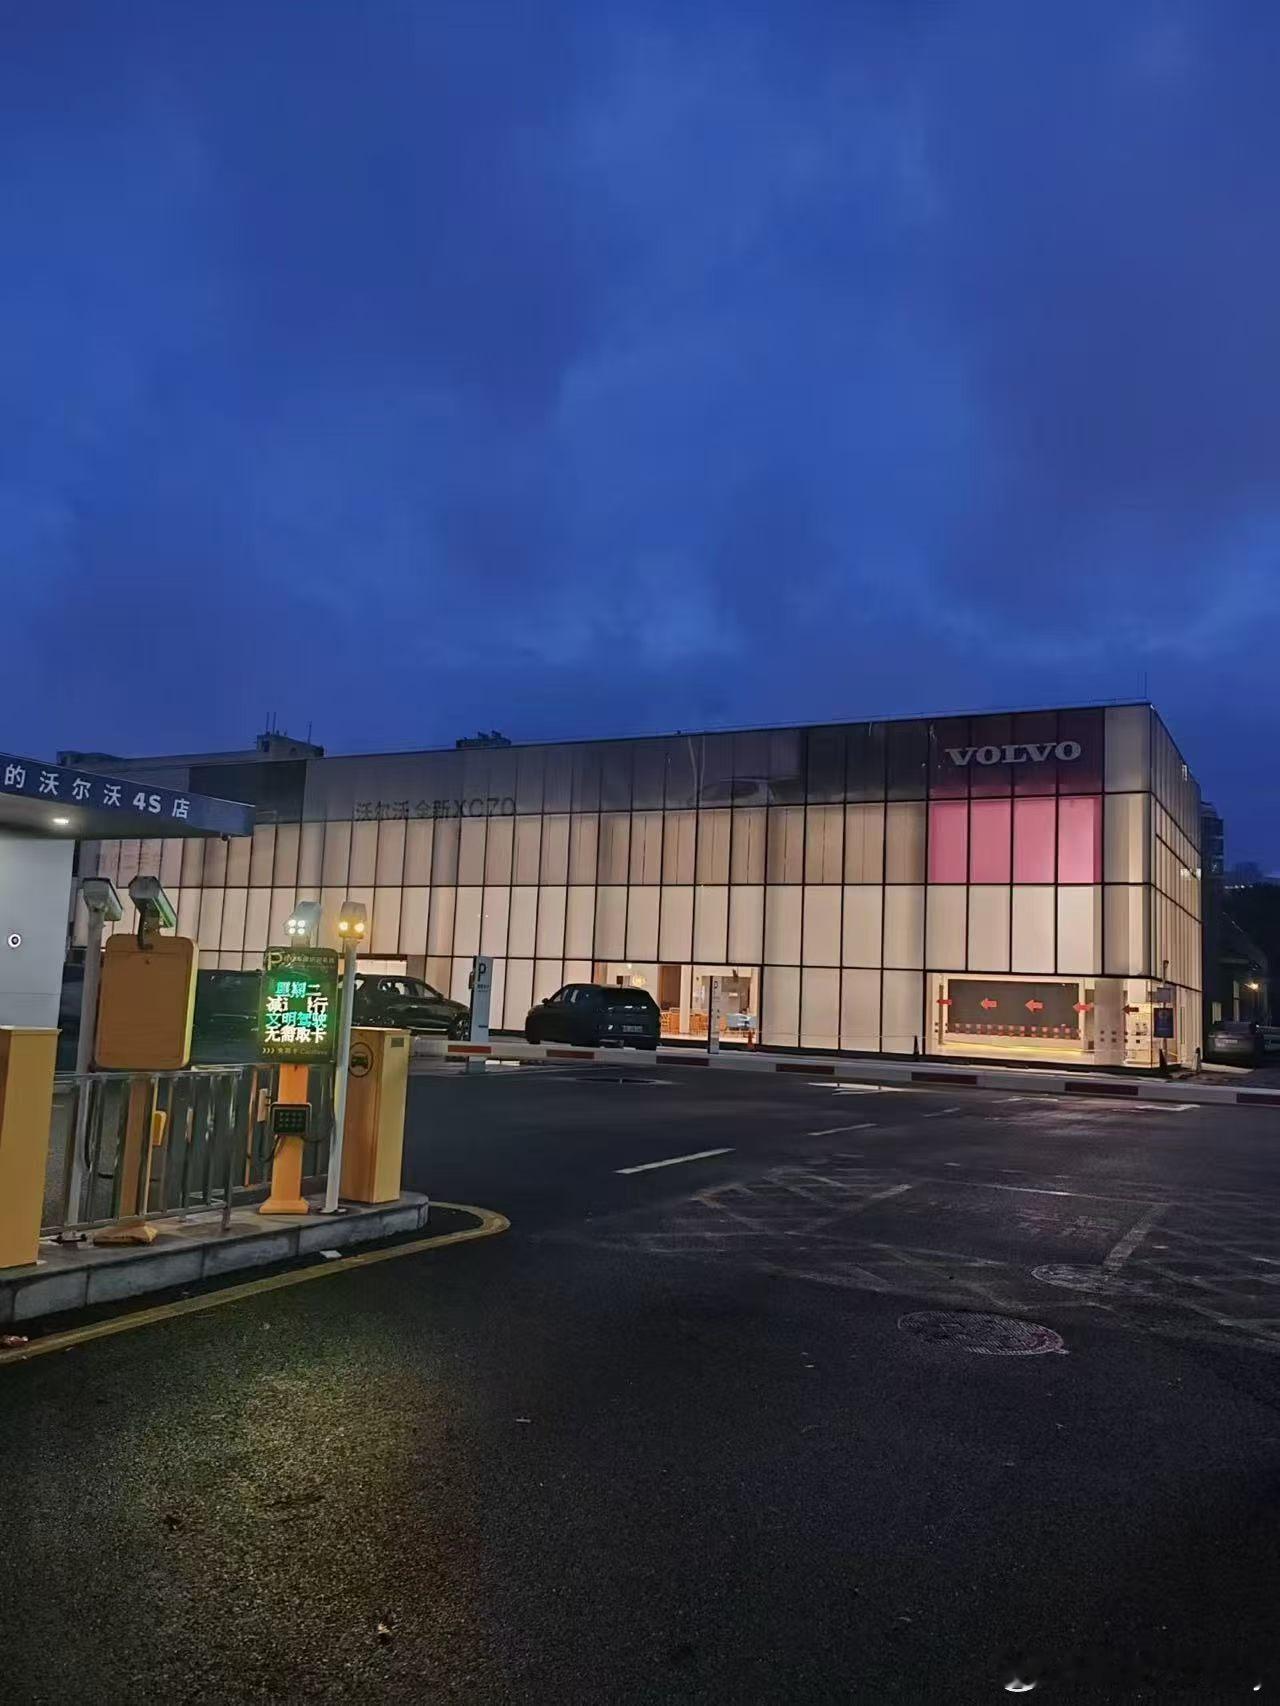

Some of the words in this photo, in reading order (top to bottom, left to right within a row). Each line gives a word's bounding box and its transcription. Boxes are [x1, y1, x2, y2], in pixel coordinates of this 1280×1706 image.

[945, 741, 1081, 765] VOLVO
[478, 963, 487, 981] P
[265, 1011, 328, 1028] 文明驾驶
[264, 1027, 328, 1044] 无需取卡
